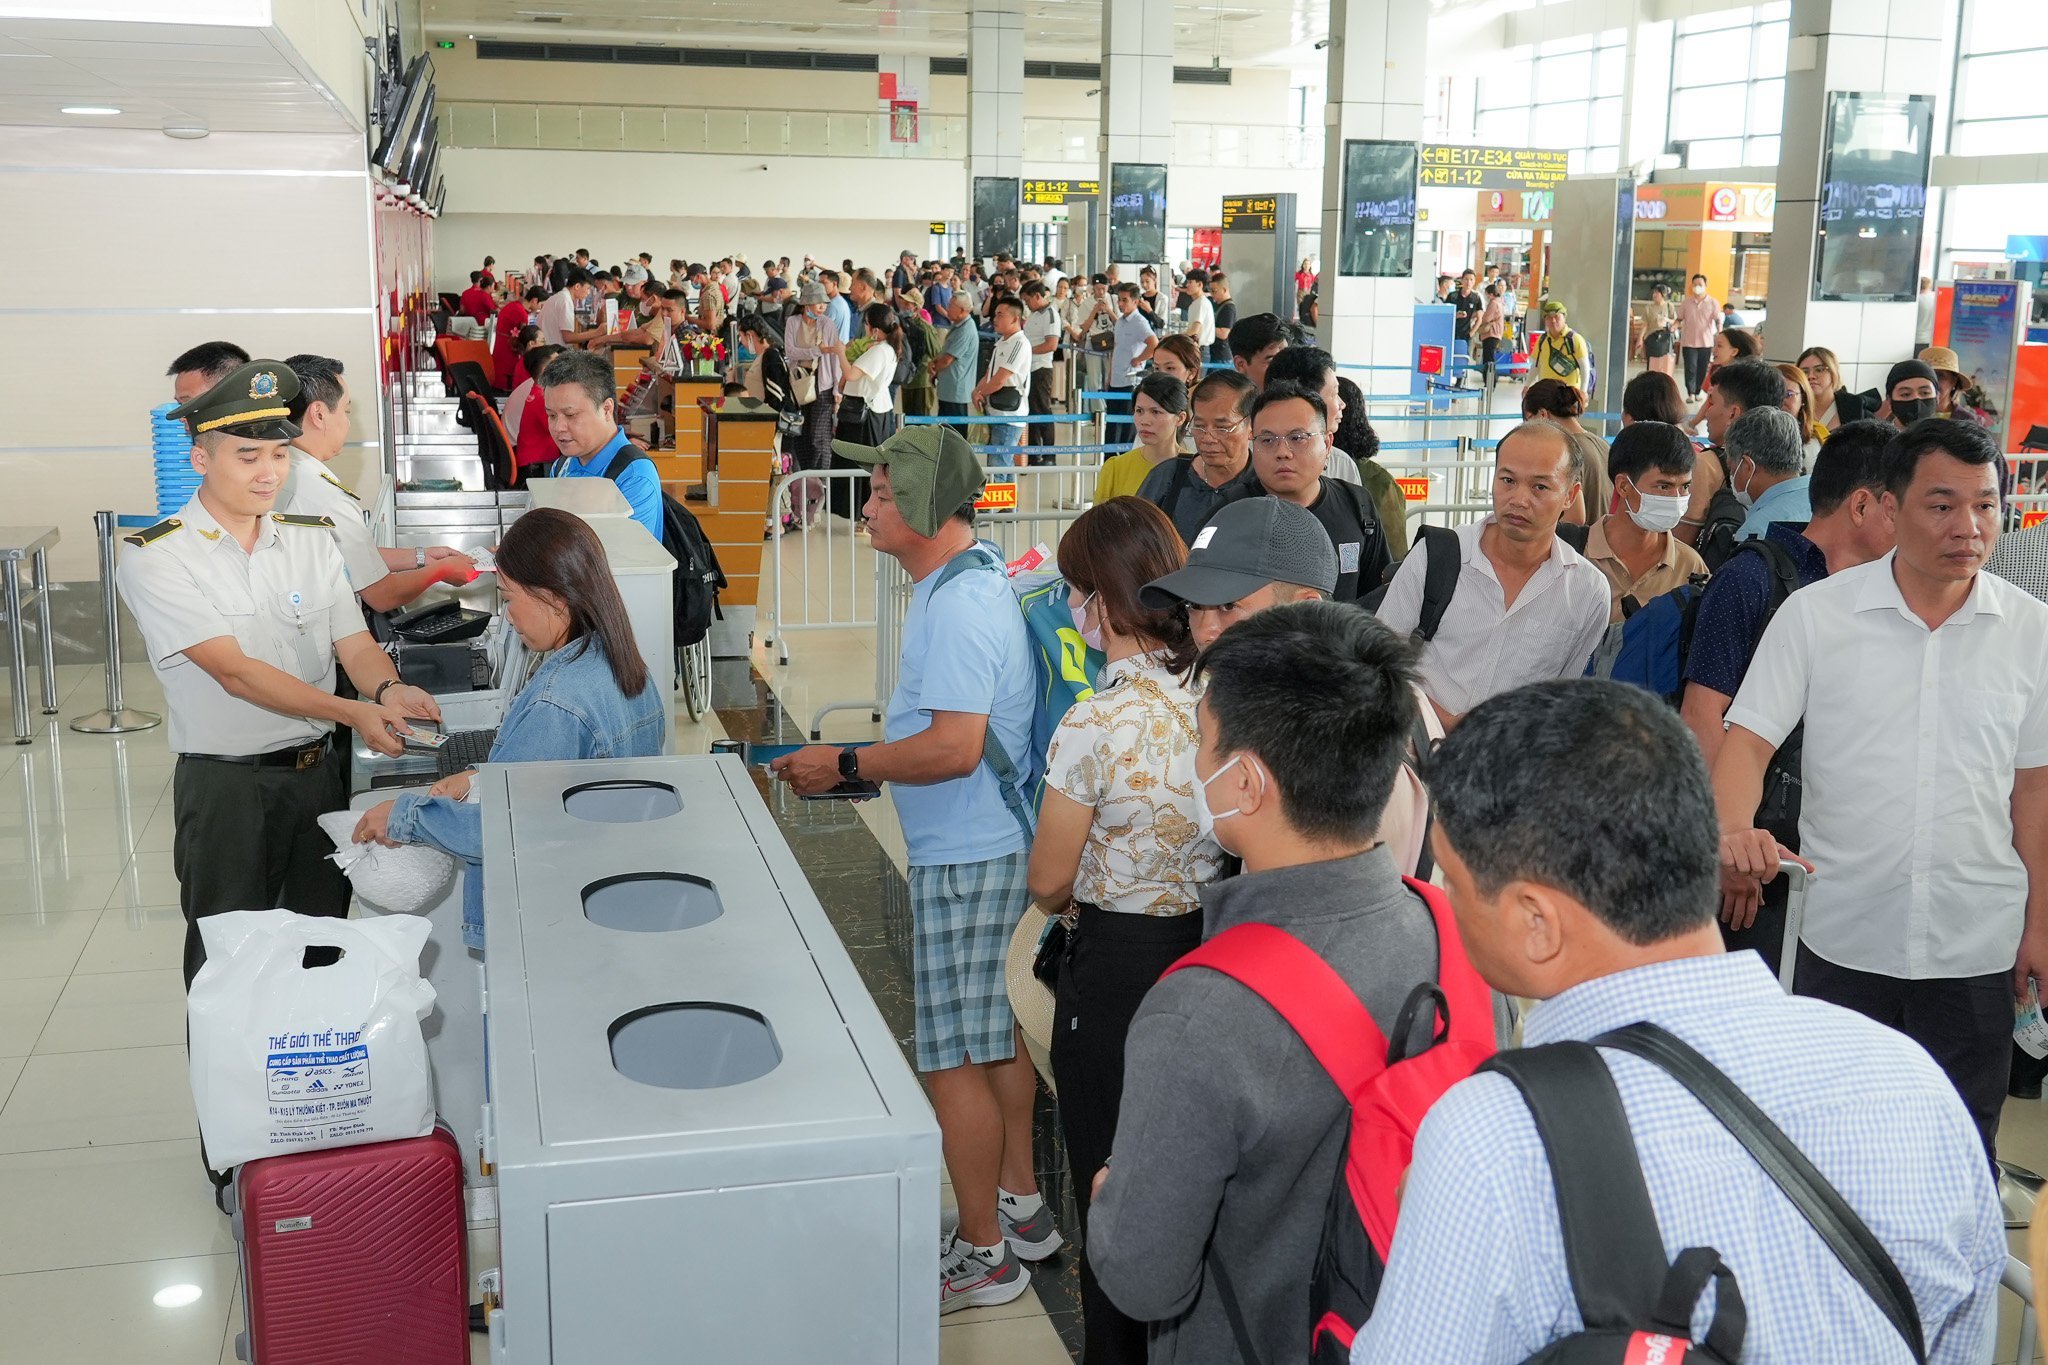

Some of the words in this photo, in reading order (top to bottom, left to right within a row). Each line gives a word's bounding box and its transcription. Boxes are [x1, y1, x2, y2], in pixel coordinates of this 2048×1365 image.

[1451, 148, 1513, 165] E17-E34
[1450, 168, 1482, 185] 1-12
[1047, 182, 1069, 192] 1-12
[269, 1032, 289, 1050] THẾ
[290, 1032, 309, 1048] GIỚI
[313, 1028, 333, 1047] THỂ
[335, 1031, 361, 1046] THAO
[326, 1055, 339, 1063] THAO
[345, 1080, 364, 1089] YONEX
